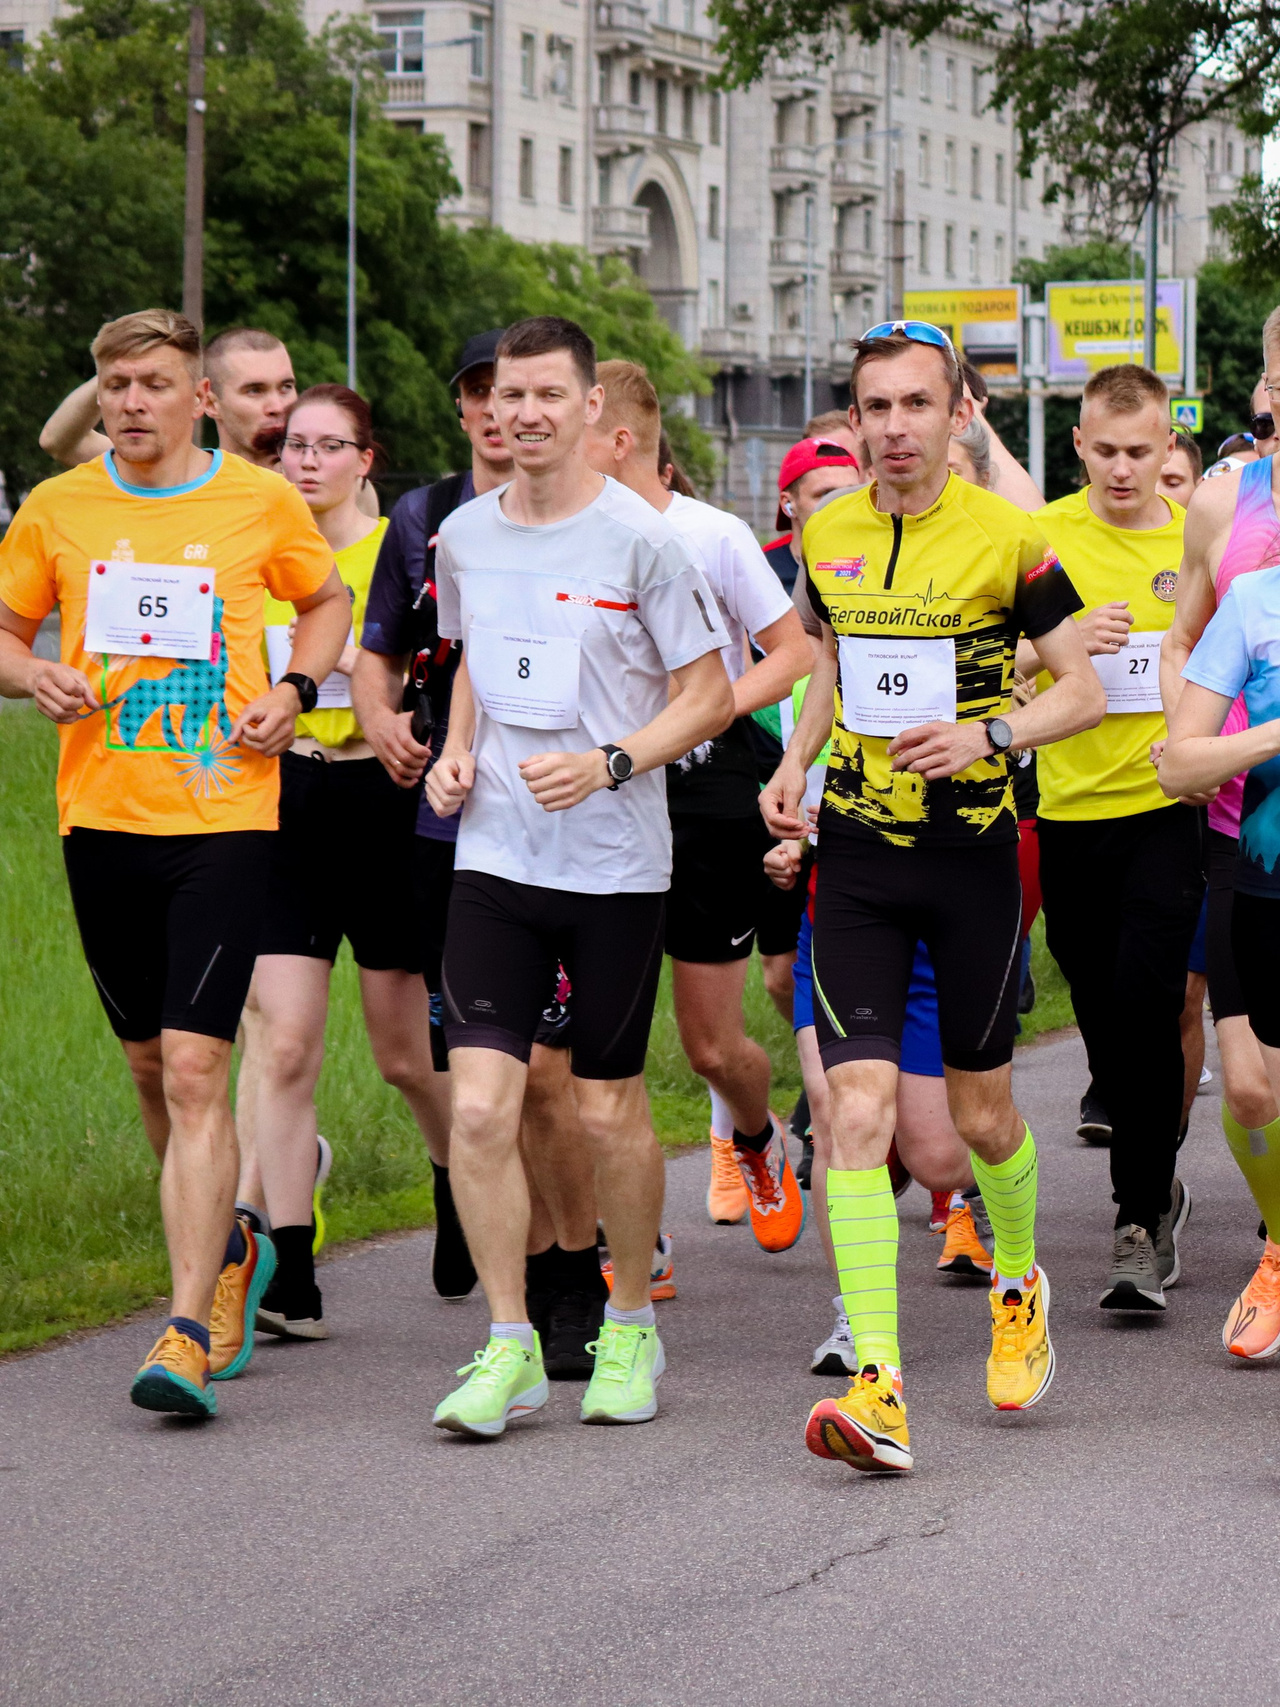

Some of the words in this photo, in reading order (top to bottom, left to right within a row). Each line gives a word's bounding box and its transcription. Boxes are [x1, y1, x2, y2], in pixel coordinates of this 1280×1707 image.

[1064, 319, 1120, 336] КЕШБЭК
[138, 595, 168, 618] 65
[517, 657, 530, 679] 8
[1129, 658, 1150, 675] 27
[876, 672, 909, 696] 49
